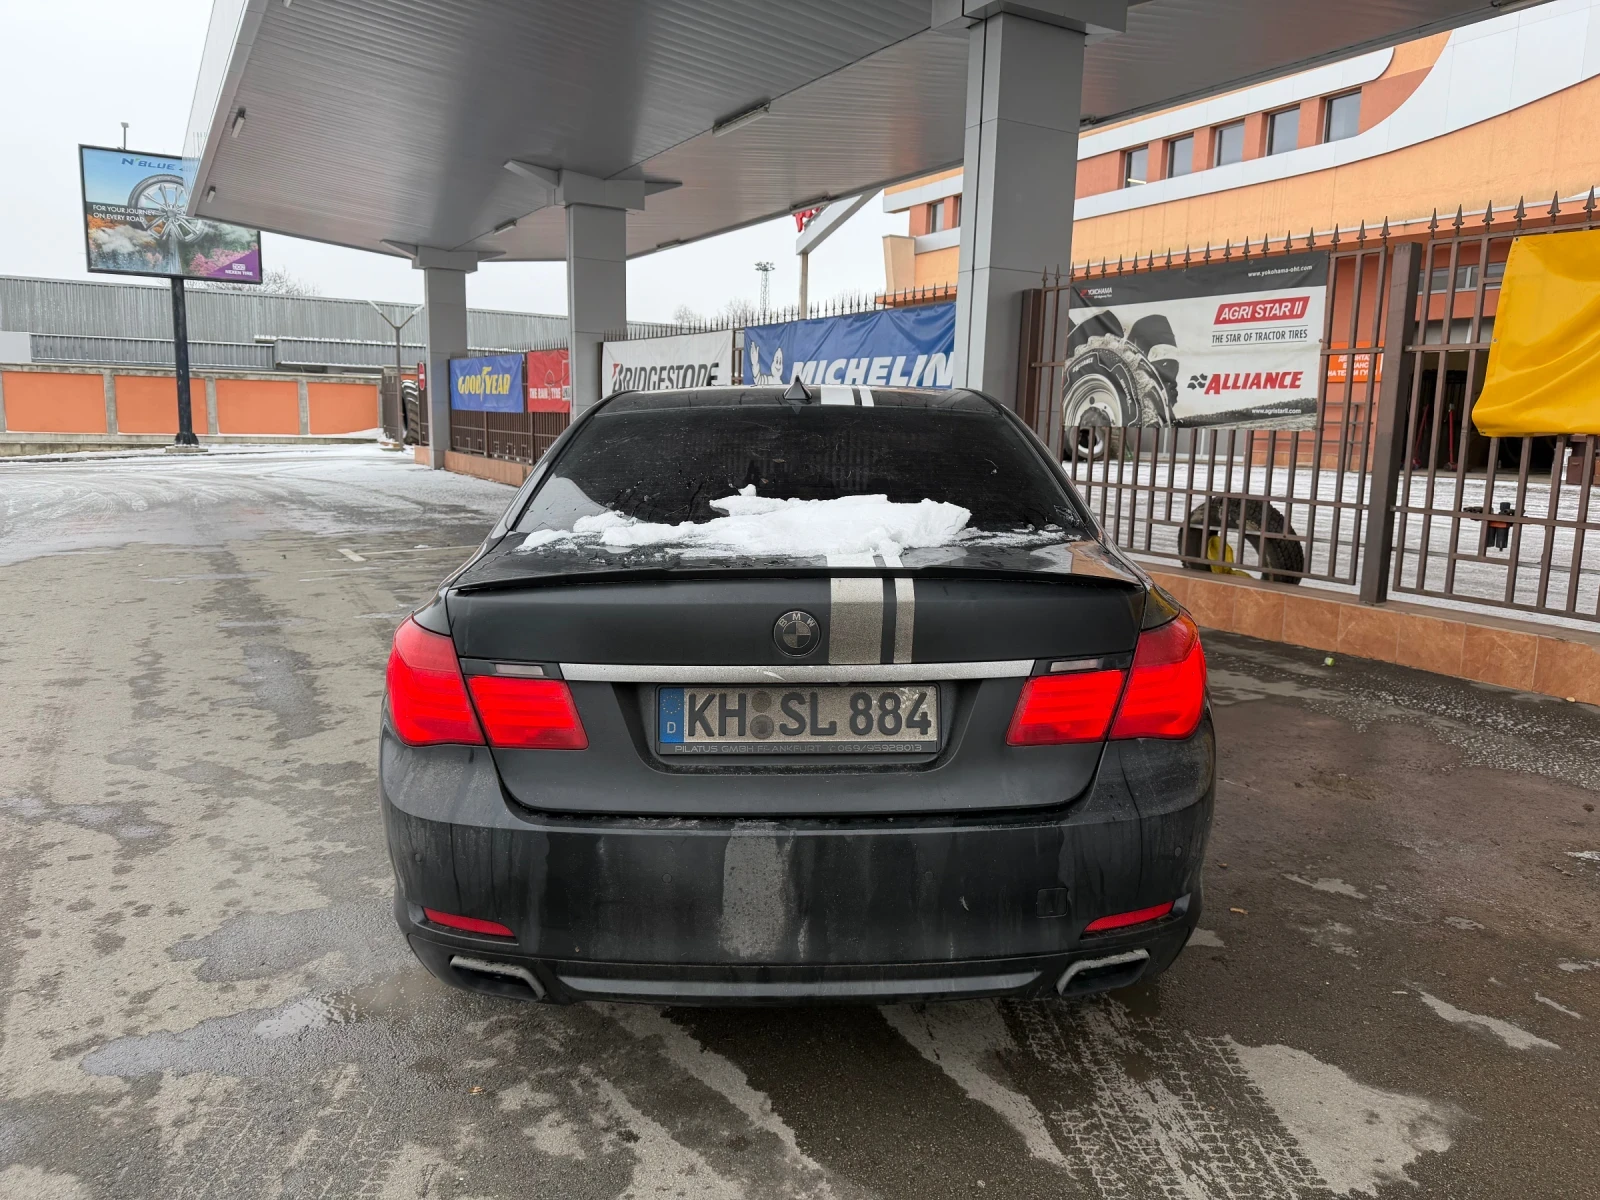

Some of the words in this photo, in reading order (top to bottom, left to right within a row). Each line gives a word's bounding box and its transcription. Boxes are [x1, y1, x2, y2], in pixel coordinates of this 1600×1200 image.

[107, 205, 126, 213] YOUR
[126, 208, 155, 216] JOURNEY
[107, 213, 125, 221] EVERY
[1219, 305, 1253, 321] AGRI
[1254, 302, 1292, 318] STAR
[1293, 300, 1304, 315] II
[1212, 334, 1223, 344] THE
[1225, 333, 1242, 343] STAR
[1243, 332, 1253, 342] OF
[1255, 330, 1286, 342] TRACTOR
[1288, 328, 1308, 339] TIRES
[790, 352, 955, 387] MICHELIN
[612, 362, 719, 394] BRIDGESTONE
[1204, 371, 1304, 395] ALLIANCE
[779, 613, 816, 627] BMW
[687, 692, 747, 737] KH
[779, 691, 838, 736] SL
[849, 691, 932, 736] 884
[666, 721, 677, 734] D
[674, 745, 718, 753] PILATUS
[721, 745, 754, 753] GMBH
[837, 744, 922, 752] 069/95928013
